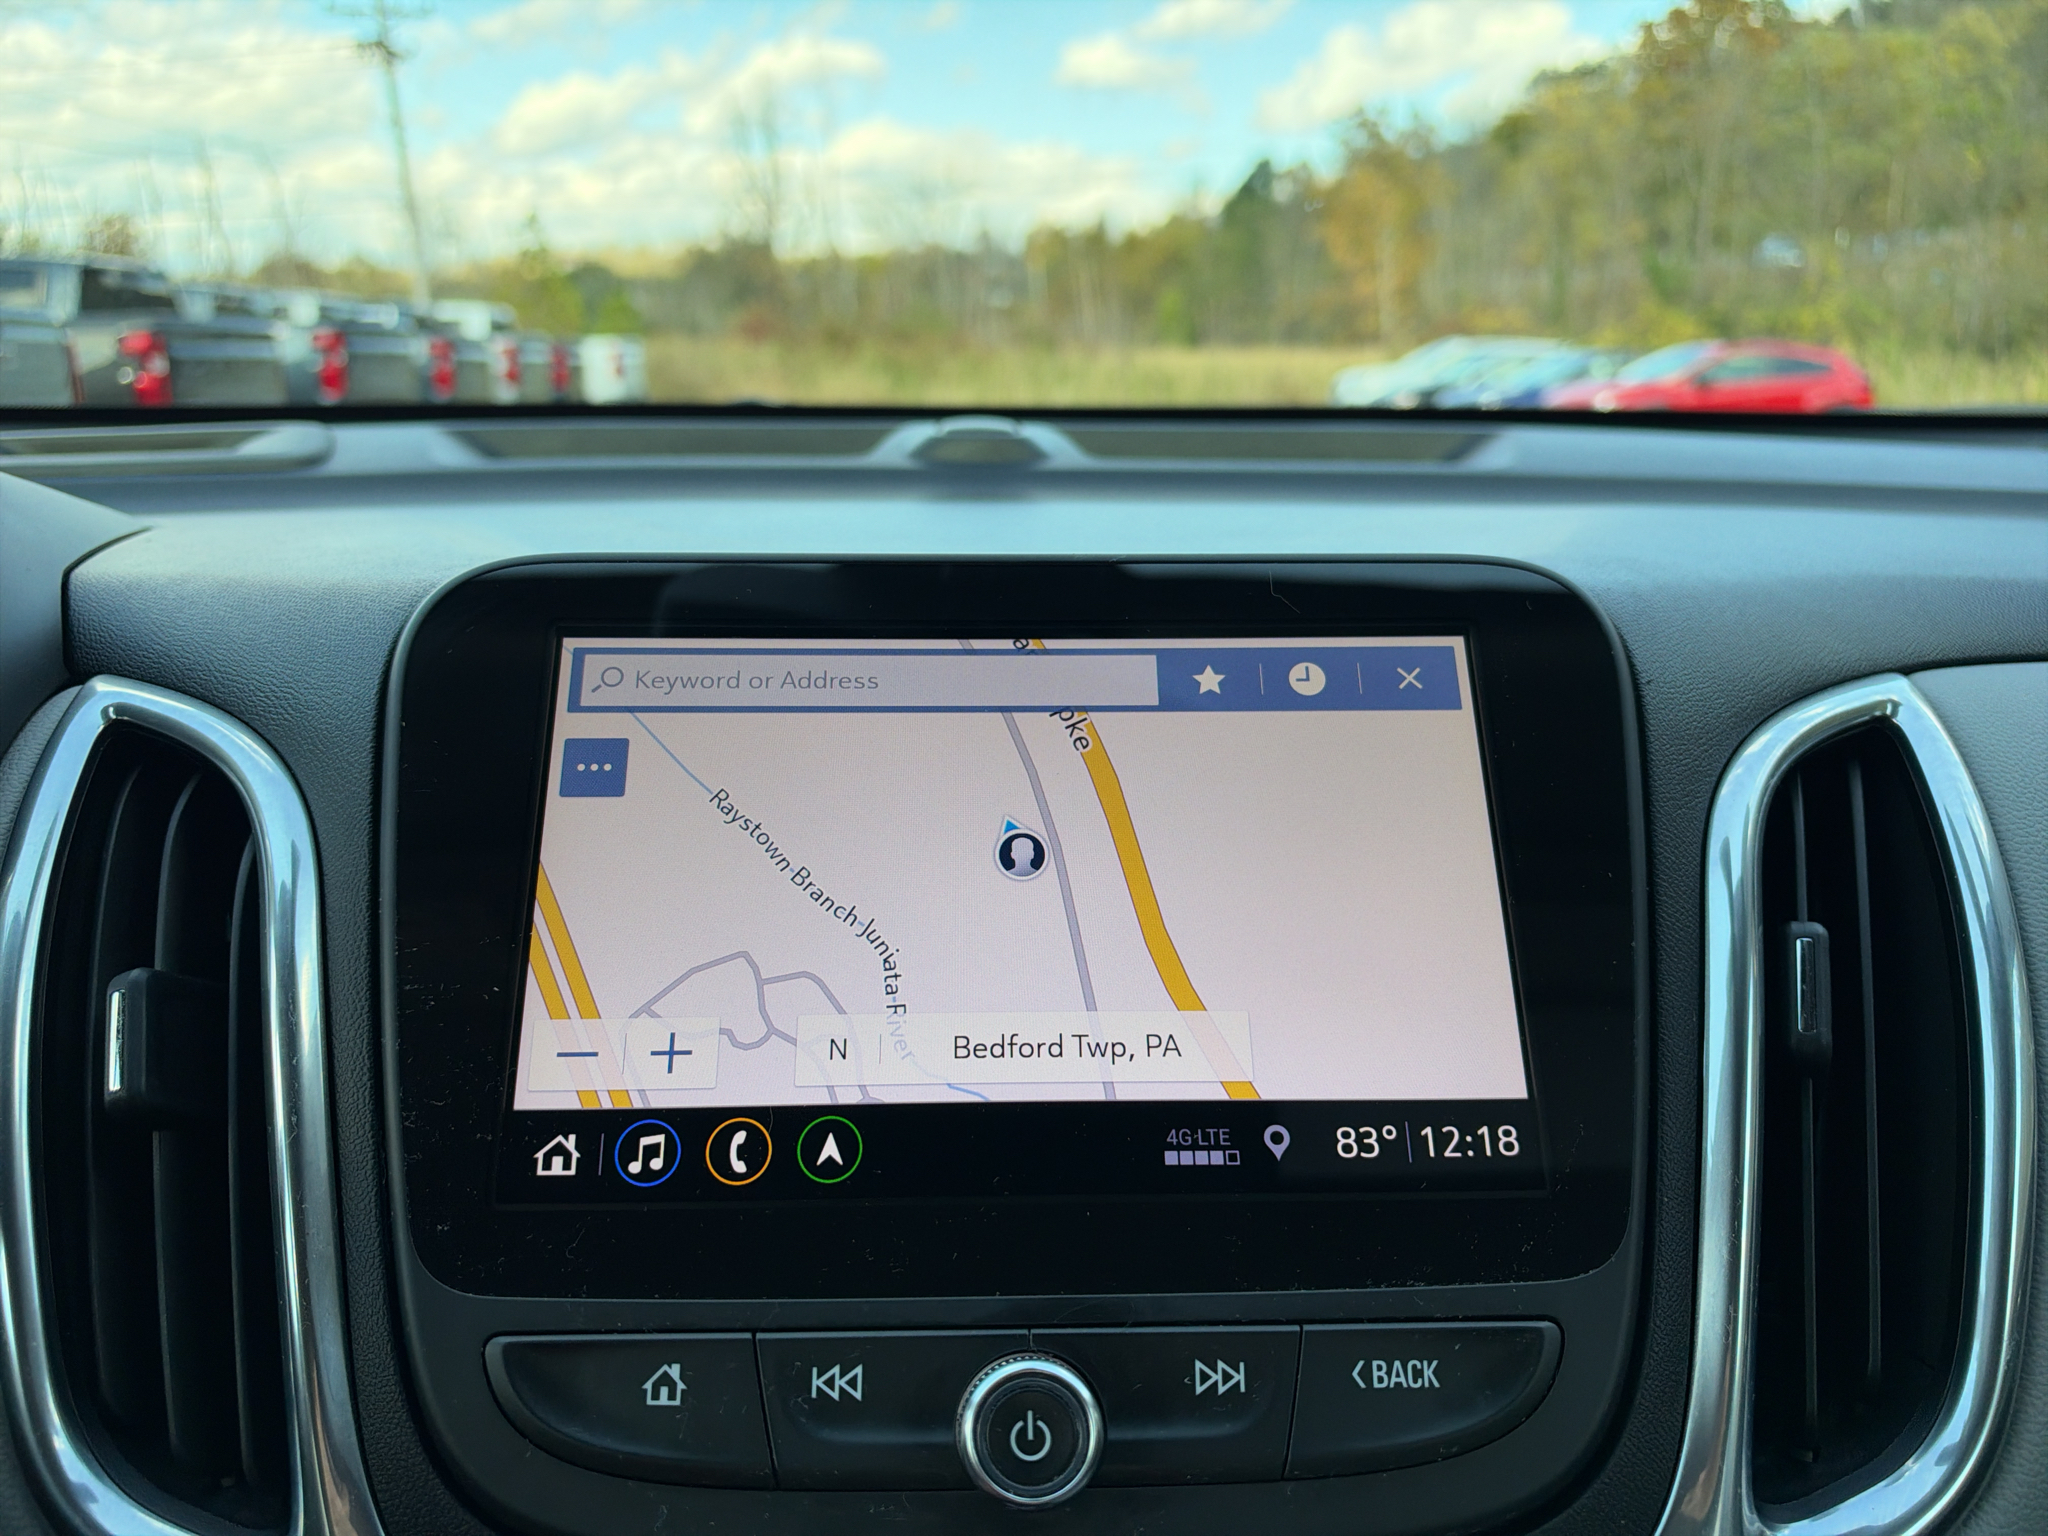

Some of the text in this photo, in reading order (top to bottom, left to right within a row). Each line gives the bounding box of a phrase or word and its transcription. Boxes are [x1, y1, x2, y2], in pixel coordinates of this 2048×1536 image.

[635, 669, 880, 696] Keyword or Address
[1049, 710, 1089, 752] pke
[708, 788, 915, 1060] Raystown Branch Juniata River
[829, 1038, 847, 1060] N
[953, 1034, 1183, 1065] Bedford Twp, PA
[1420, 1125, 1521, 1158] 12:18
[1371, 1359, 1441, 1389] BACK
